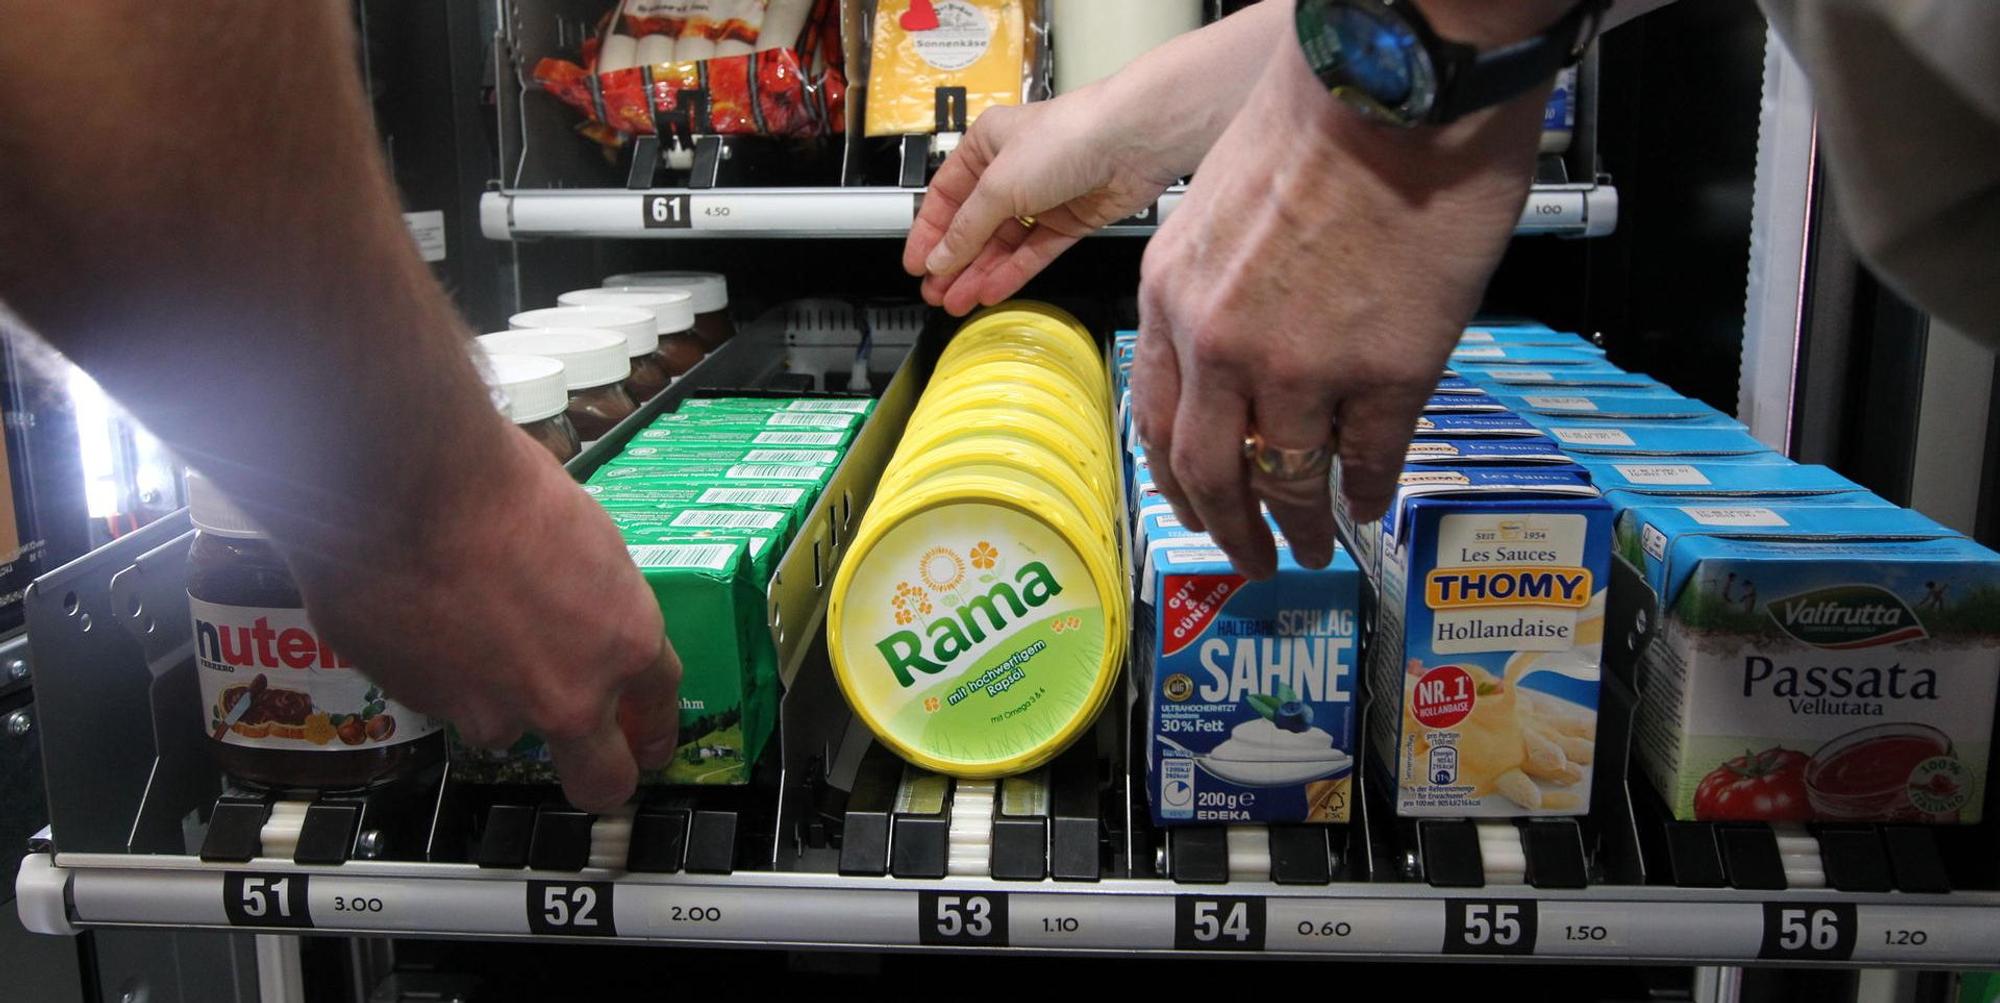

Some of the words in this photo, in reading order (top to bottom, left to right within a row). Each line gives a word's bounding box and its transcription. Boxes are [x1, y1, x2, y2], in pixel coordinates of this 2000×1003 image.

[916, 38, 987, 48] Sonnenkäse
[652, 197, 681, 221] 61
[705, 207, 730, 216] 4.50
[1536, 204, 1562, 216] 1.00
[1475, 532, 1496, 540] SEIT
[1523, 531, 1547, 540] 1954
[1461, 547, 1490, 562] Les
[1496, 546, 1557, 562] Sauces
[1168, 580, 1196, 609] GUT
[1433, 572, 1584, 600] THOMY
[1173, 583, 1229, 638] GÜNSTIG
[1185, 598, 1198, 610] &
[1784, 598, 1901, 626] Valfrutta
[875, 560, 1063, 688] Rama
[1278, 608, 1353, 637] SCHLAG
[1437, 617, 1569, 641] Hollandaise
[200, 658, 235, 673] FERRERO
[947, 685, 969, 706] mit
[966, 639, 1047, 693] hochwertigem
[1200, 637, 1353, 703] SAHNE
[1743, 655, 1939, 700] Passata
[986, 666, 1026, 698] Rapsöl
[1419, 679, 1451, 706] NR.
[1004, 702, 1031, 719] Omega
[1789, 698, 1884, 716] Vellutata
[1195, 719, 1225, 732] Fett
[1197, 810, 1251, 820] EDEKA
[242, 877, 292, 918] 51
[334, 896, 384, 913] 3.00
[544, 886, 598, 927] 52
[671, 906, 721, 923] 2.00
[937, 896, 992, 937] 53
[1042, 916, 1079, 933] 1.10
[1194, 901, 1251, 942] 54
[1463, 903, 1521, 946] 55
[1298, 920, 1352, 937] 0.60
[1565, 924, 1607, 941] 1.50
[1779, 908, 1838, 951] 56
[1884, 929, 1928, 947] 1.20
